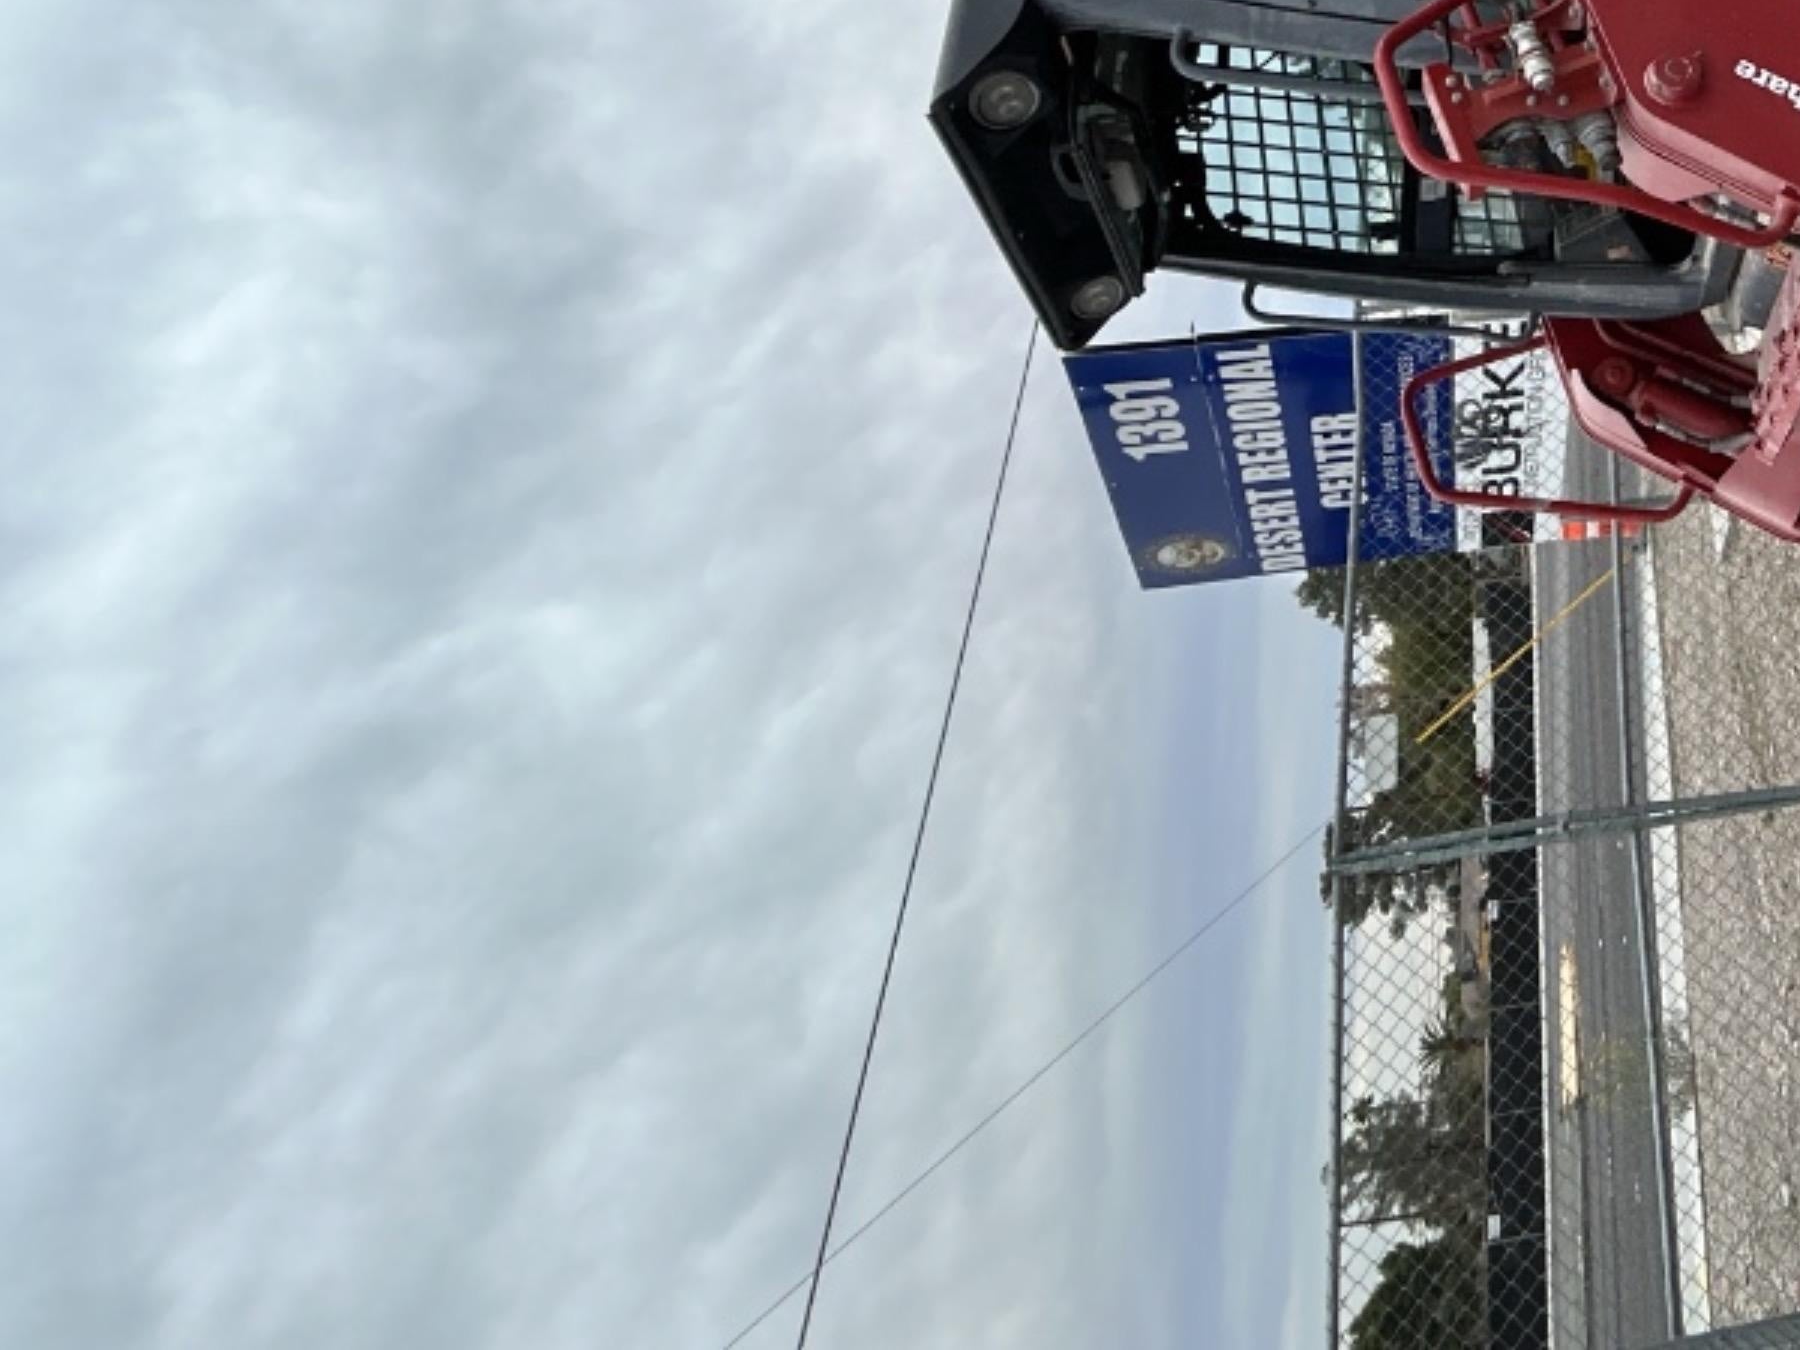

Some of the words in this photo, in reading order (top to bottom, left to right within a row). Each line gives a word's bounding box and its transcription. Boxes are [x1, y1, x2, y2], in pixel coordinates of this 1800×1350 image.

[1102, 376, 1190, 462] 1391
[1214, 343, 1292, 484] REGIONAL
[1310, 411, 1367, 508] CENTER
[1245, 488, 1307, 572] DESERT
